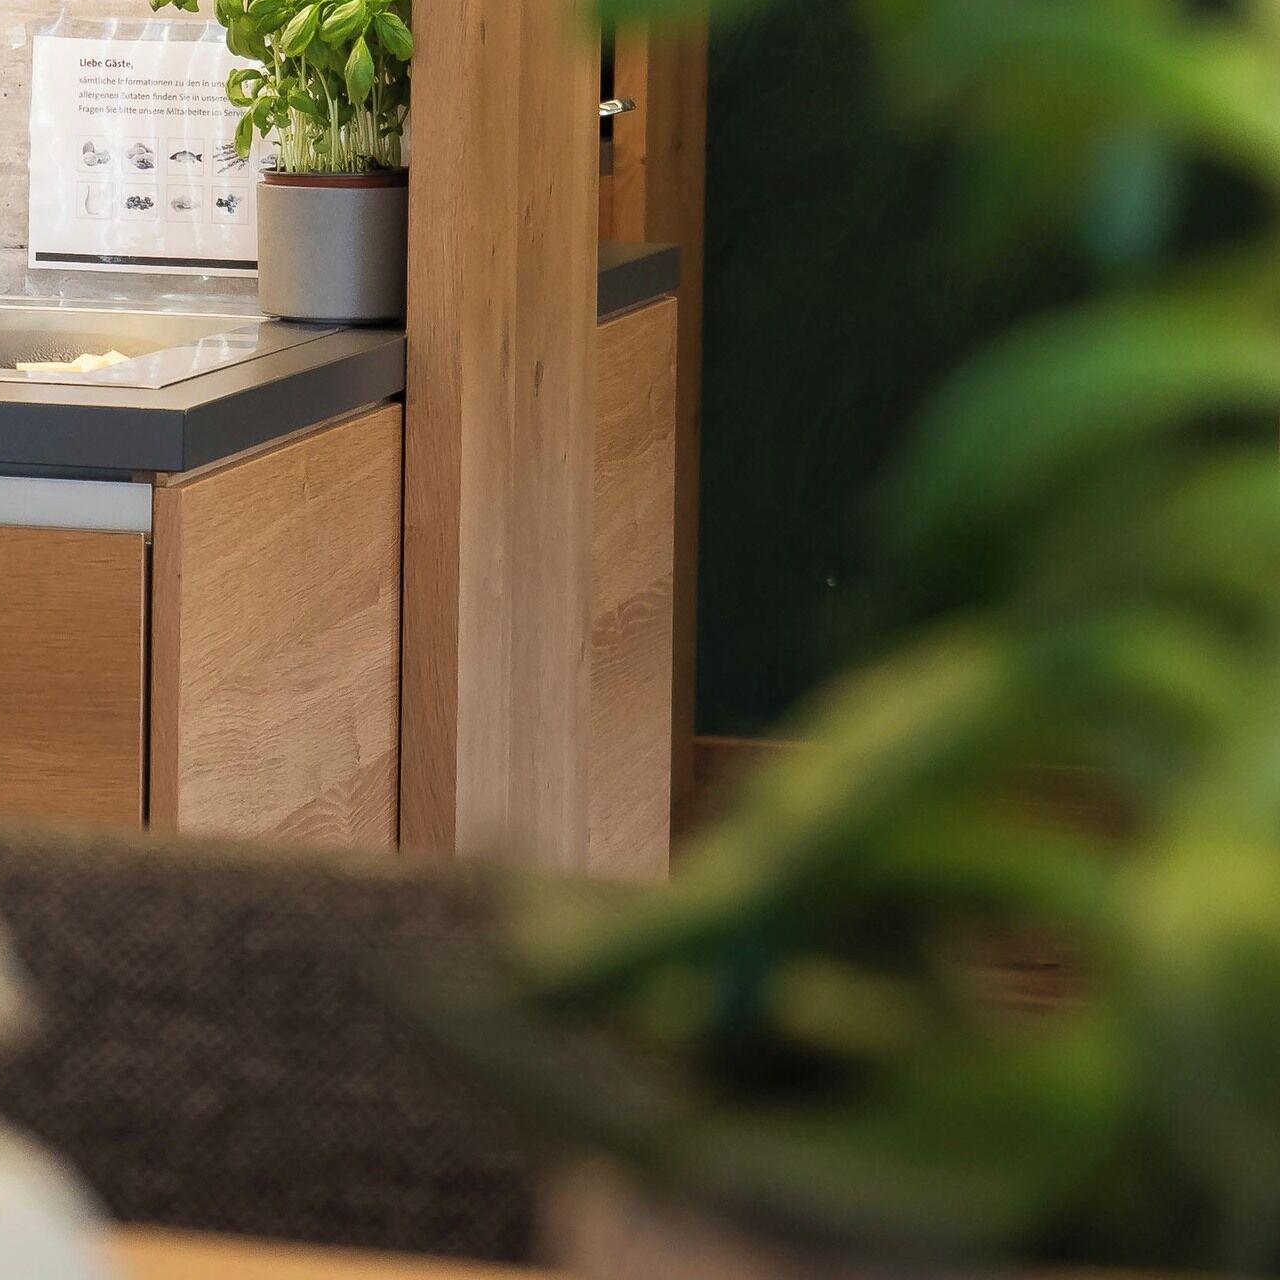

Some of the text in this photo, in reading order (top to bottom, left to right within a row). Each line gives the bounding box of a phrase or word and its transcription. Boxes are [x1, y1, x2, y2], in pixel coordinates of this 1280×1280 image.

[79, 58, 134, 70] Liebe Gäste,
[186, 79, 201, 88] den
[202, 79, 210, 88] in
[152, 92, 178, 101] finden
[192, 94, 200, 102] in
[166, 107, 211, 116] Mitarbeiter
